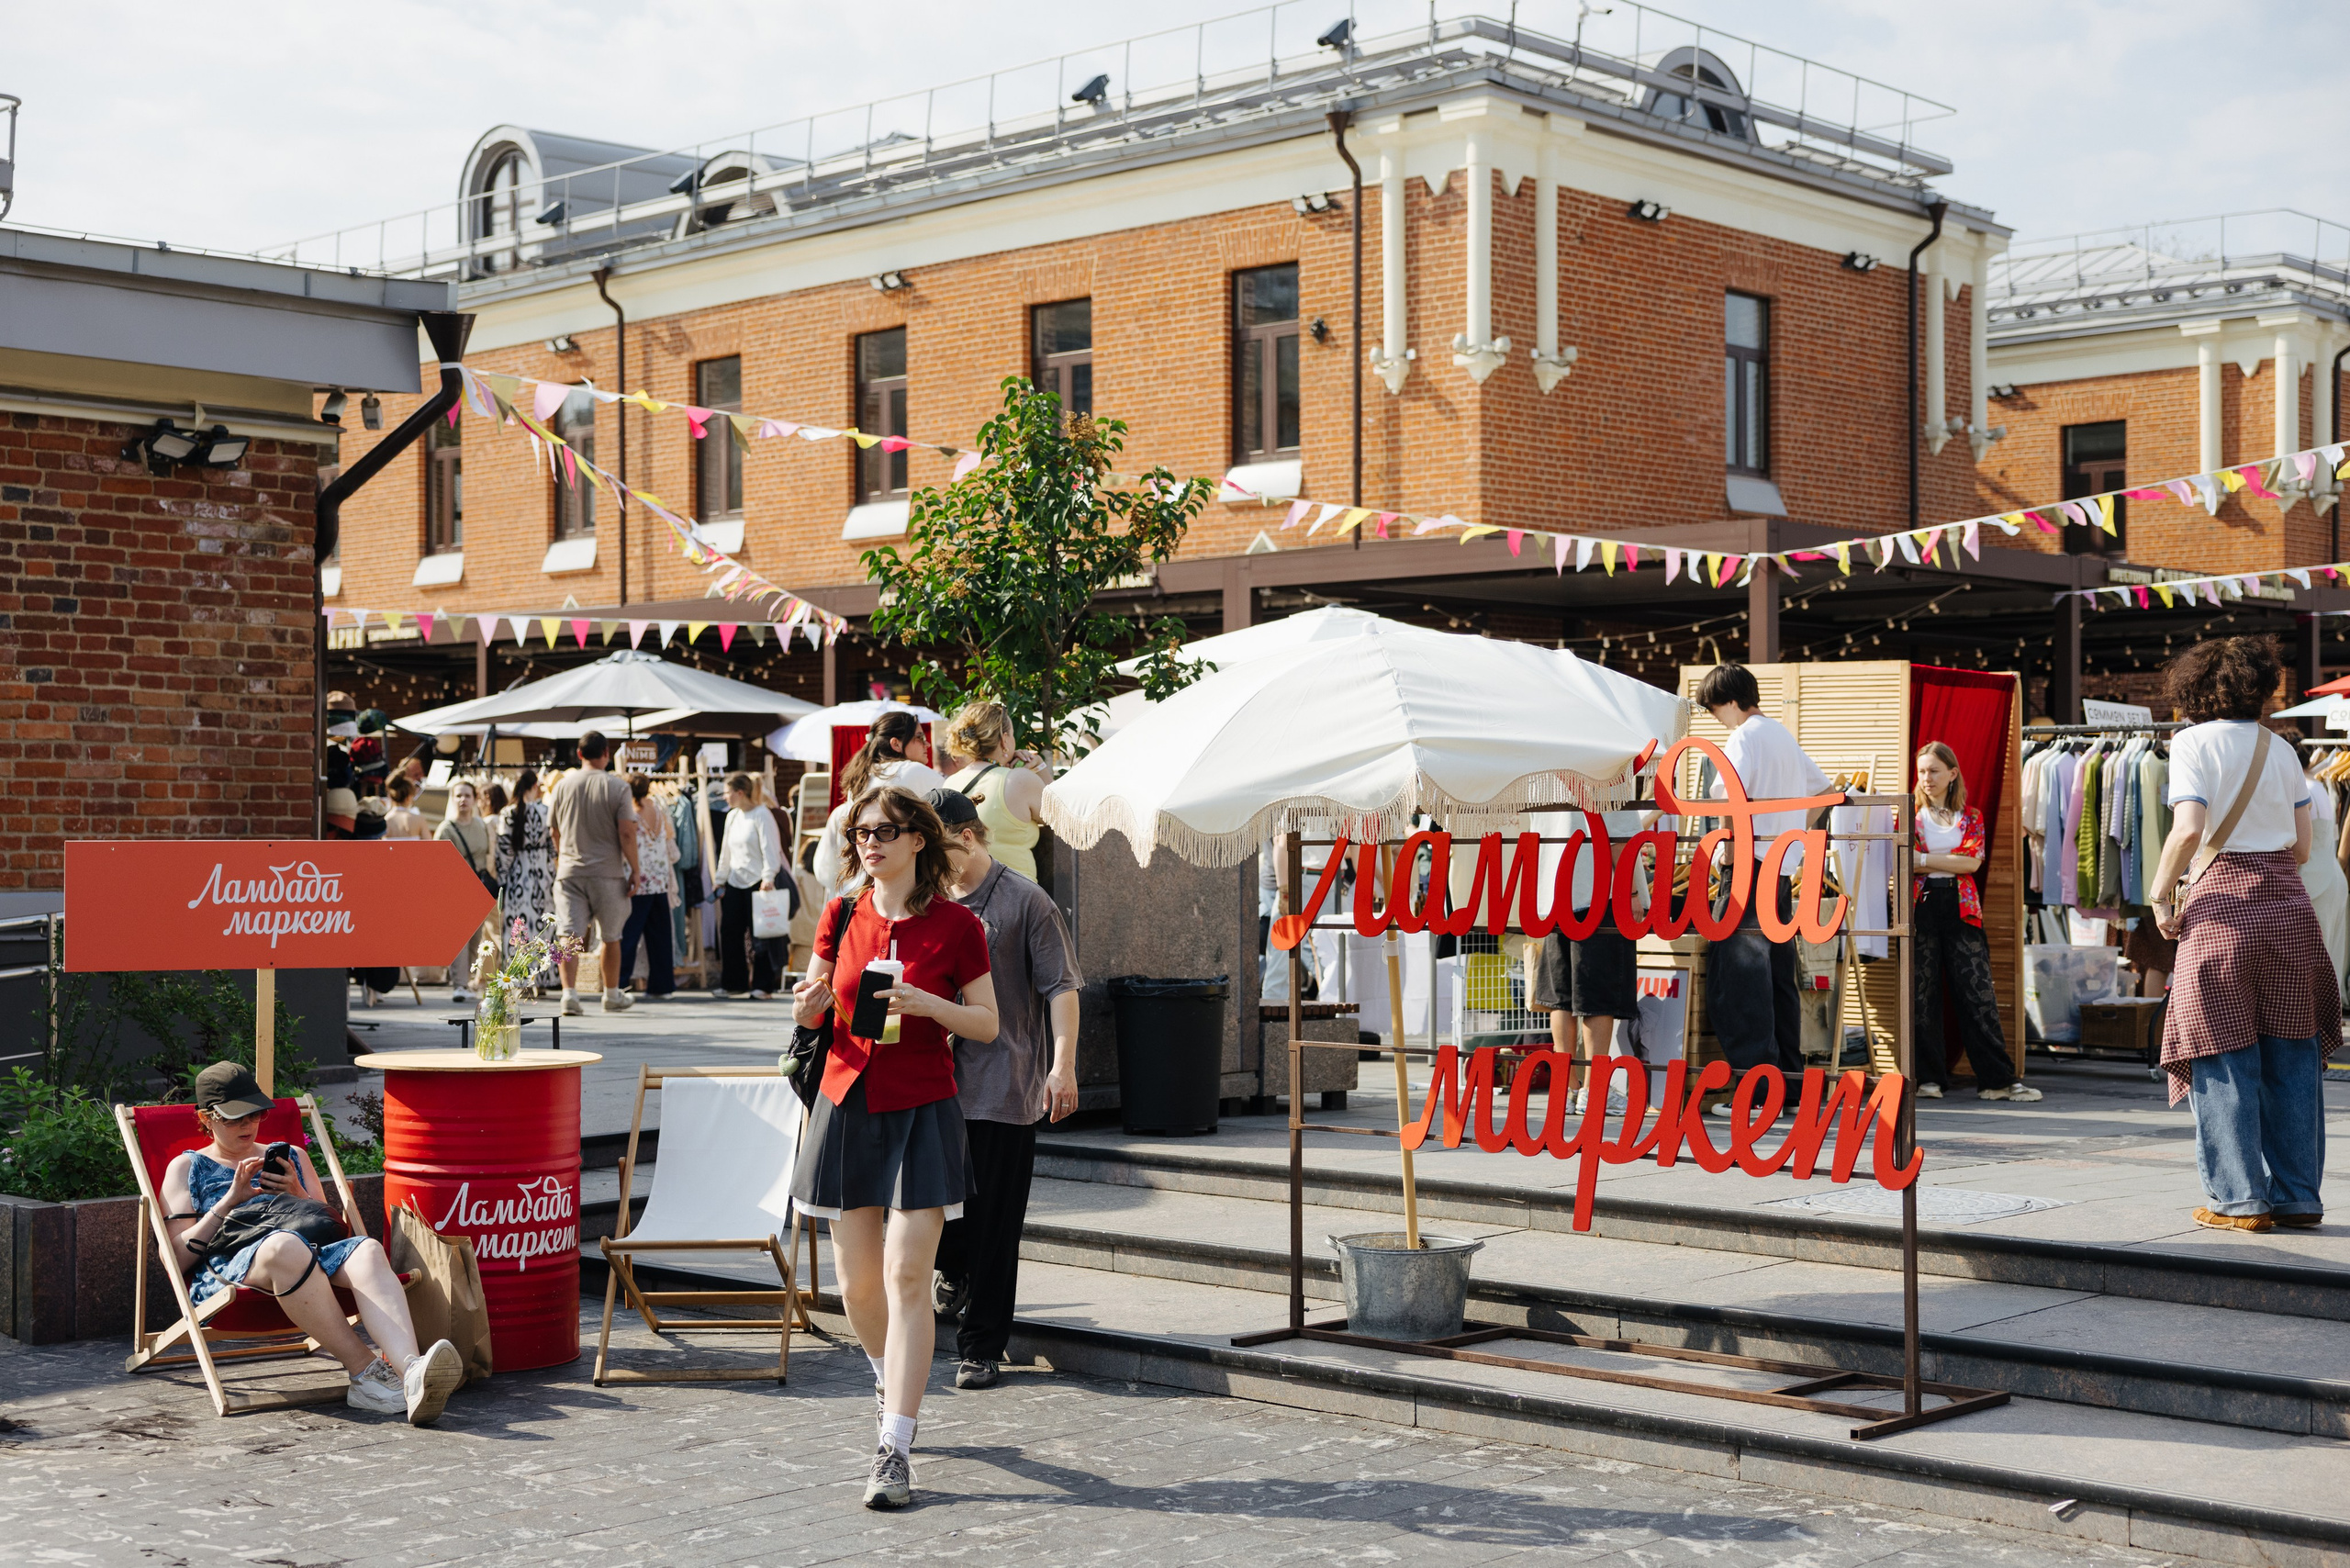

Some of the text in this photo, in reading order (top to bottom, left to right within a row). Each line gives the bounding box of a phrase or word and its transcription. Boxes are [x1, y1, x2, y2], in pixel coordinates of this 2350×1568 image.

[2087, 708, 2141, 724] COMMON SET
[187, 860, 343, 910] Ламбада
[222, 910, 355, 949] маркет
[1401, 1045, 1924, 1232] маркет
[434, 1176, 574, 1231] Ламбада
[475, 1224, 577, 1272] маркет
